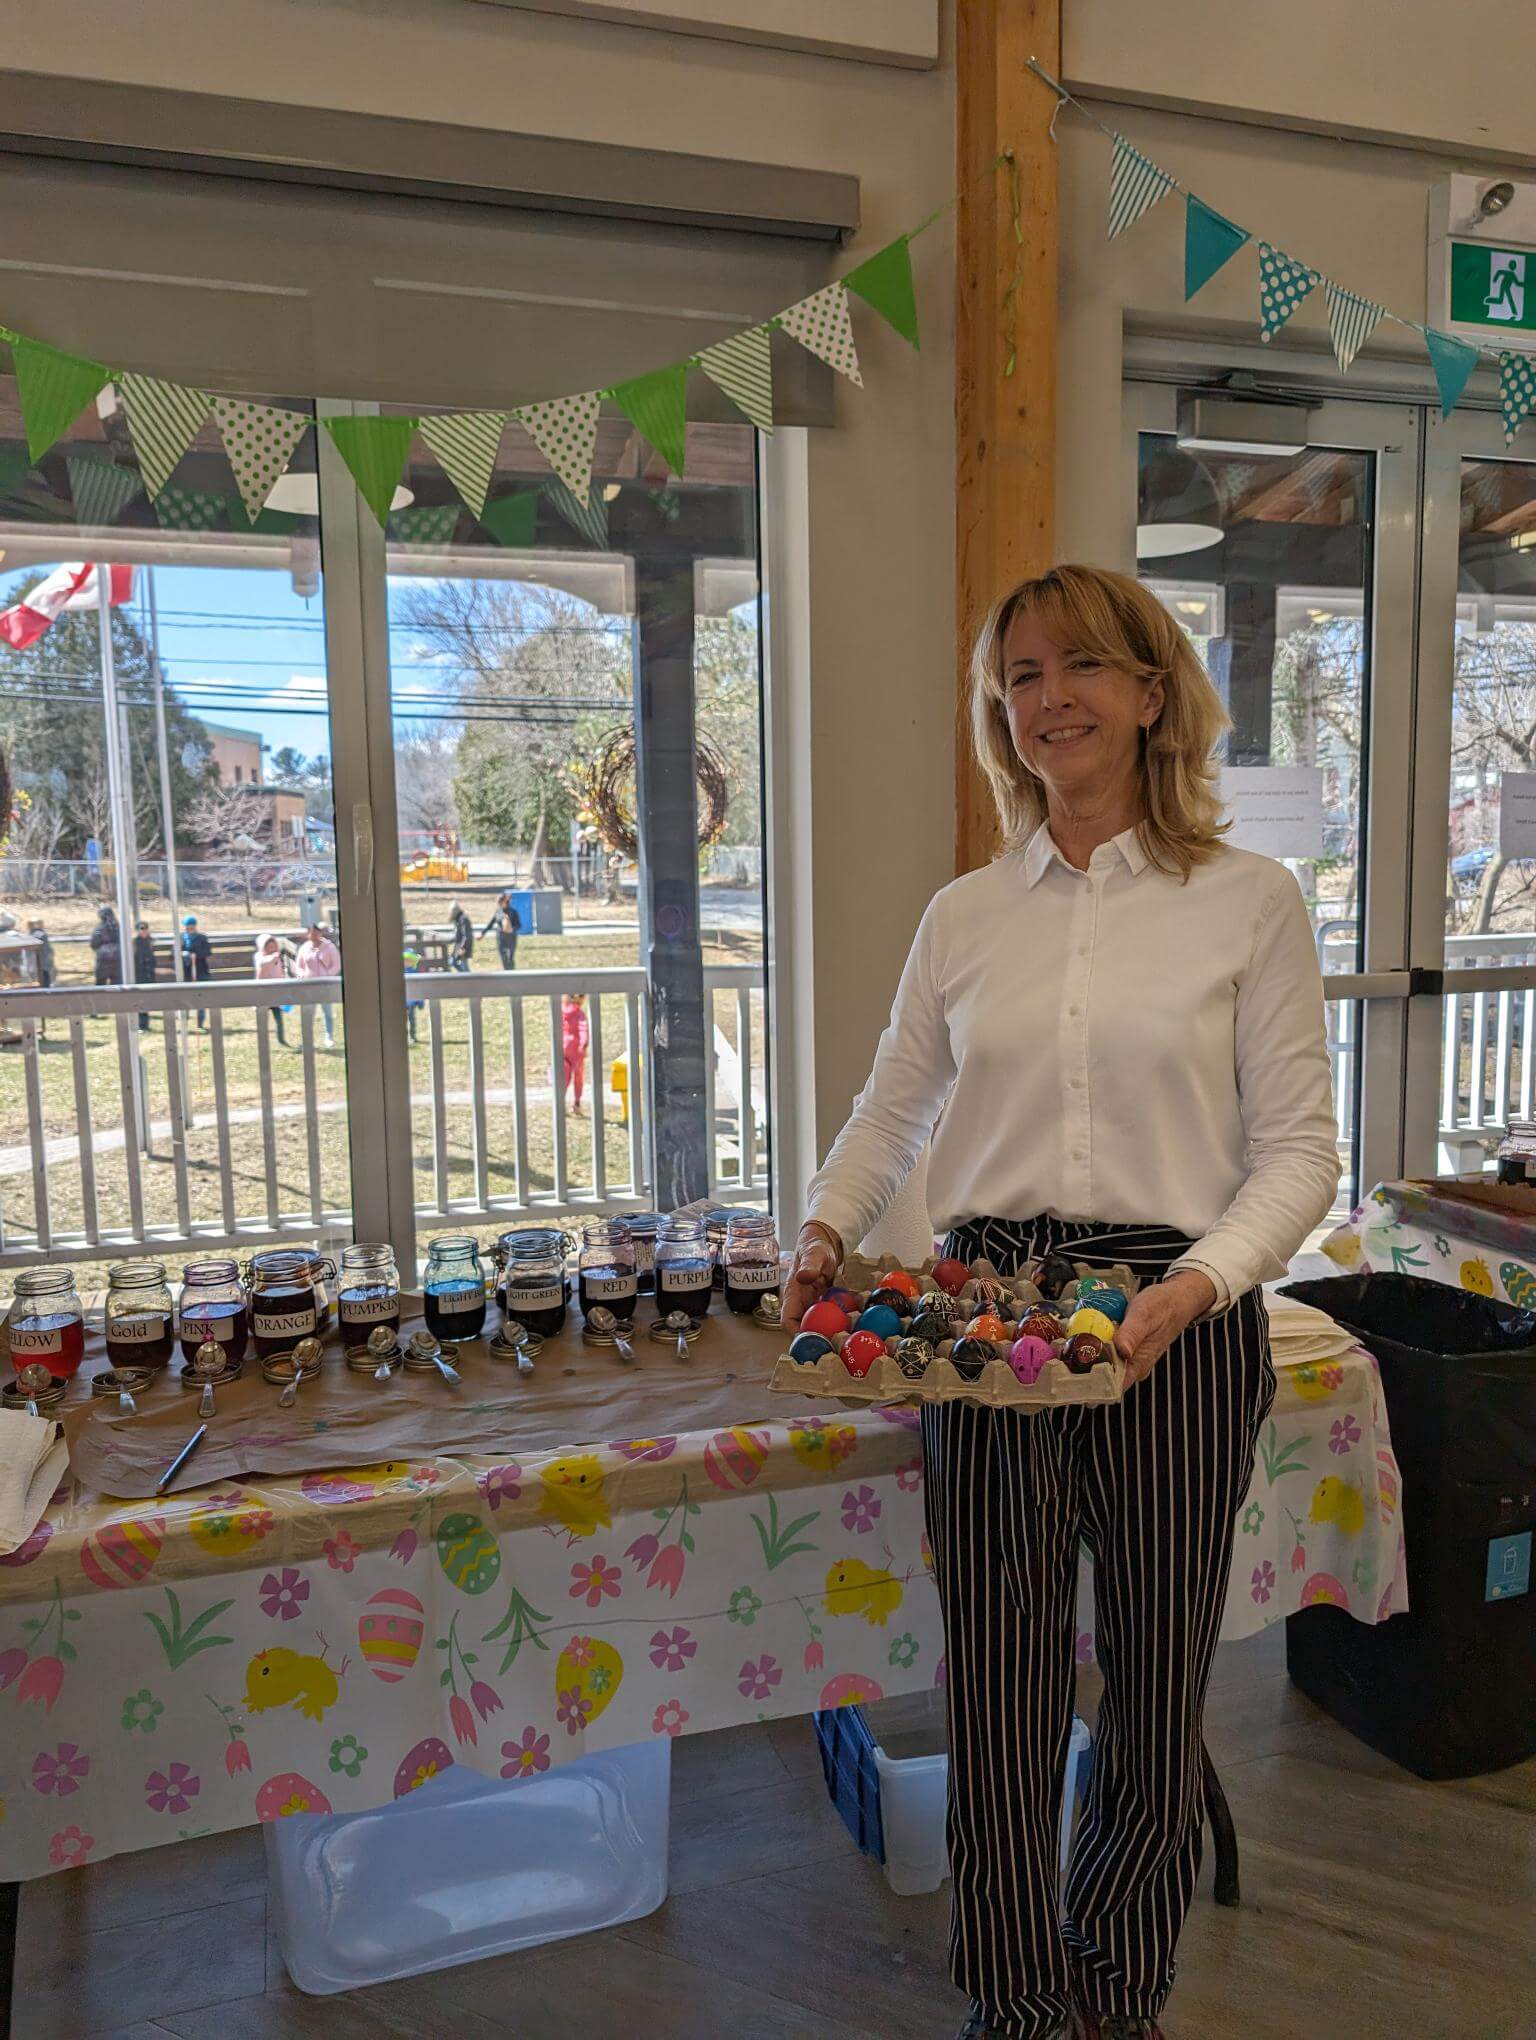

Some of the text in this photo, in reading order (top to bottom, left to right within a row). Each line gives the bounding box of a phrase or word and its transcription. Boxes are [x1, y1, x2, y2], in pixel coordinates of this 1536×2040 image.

[729, 1269, 778, 1283] SCARLET
[602, 1279, 628, 1293] RED
[531, 1287, 561, 1300] GREEN
[343, 1298, 399, 1315] PUMPKIN
[184, 1321, 215, 1335] PINK
[255, 1313, 312, 1331] ORANGE
[111, 1322, 148, 1338] Gold
